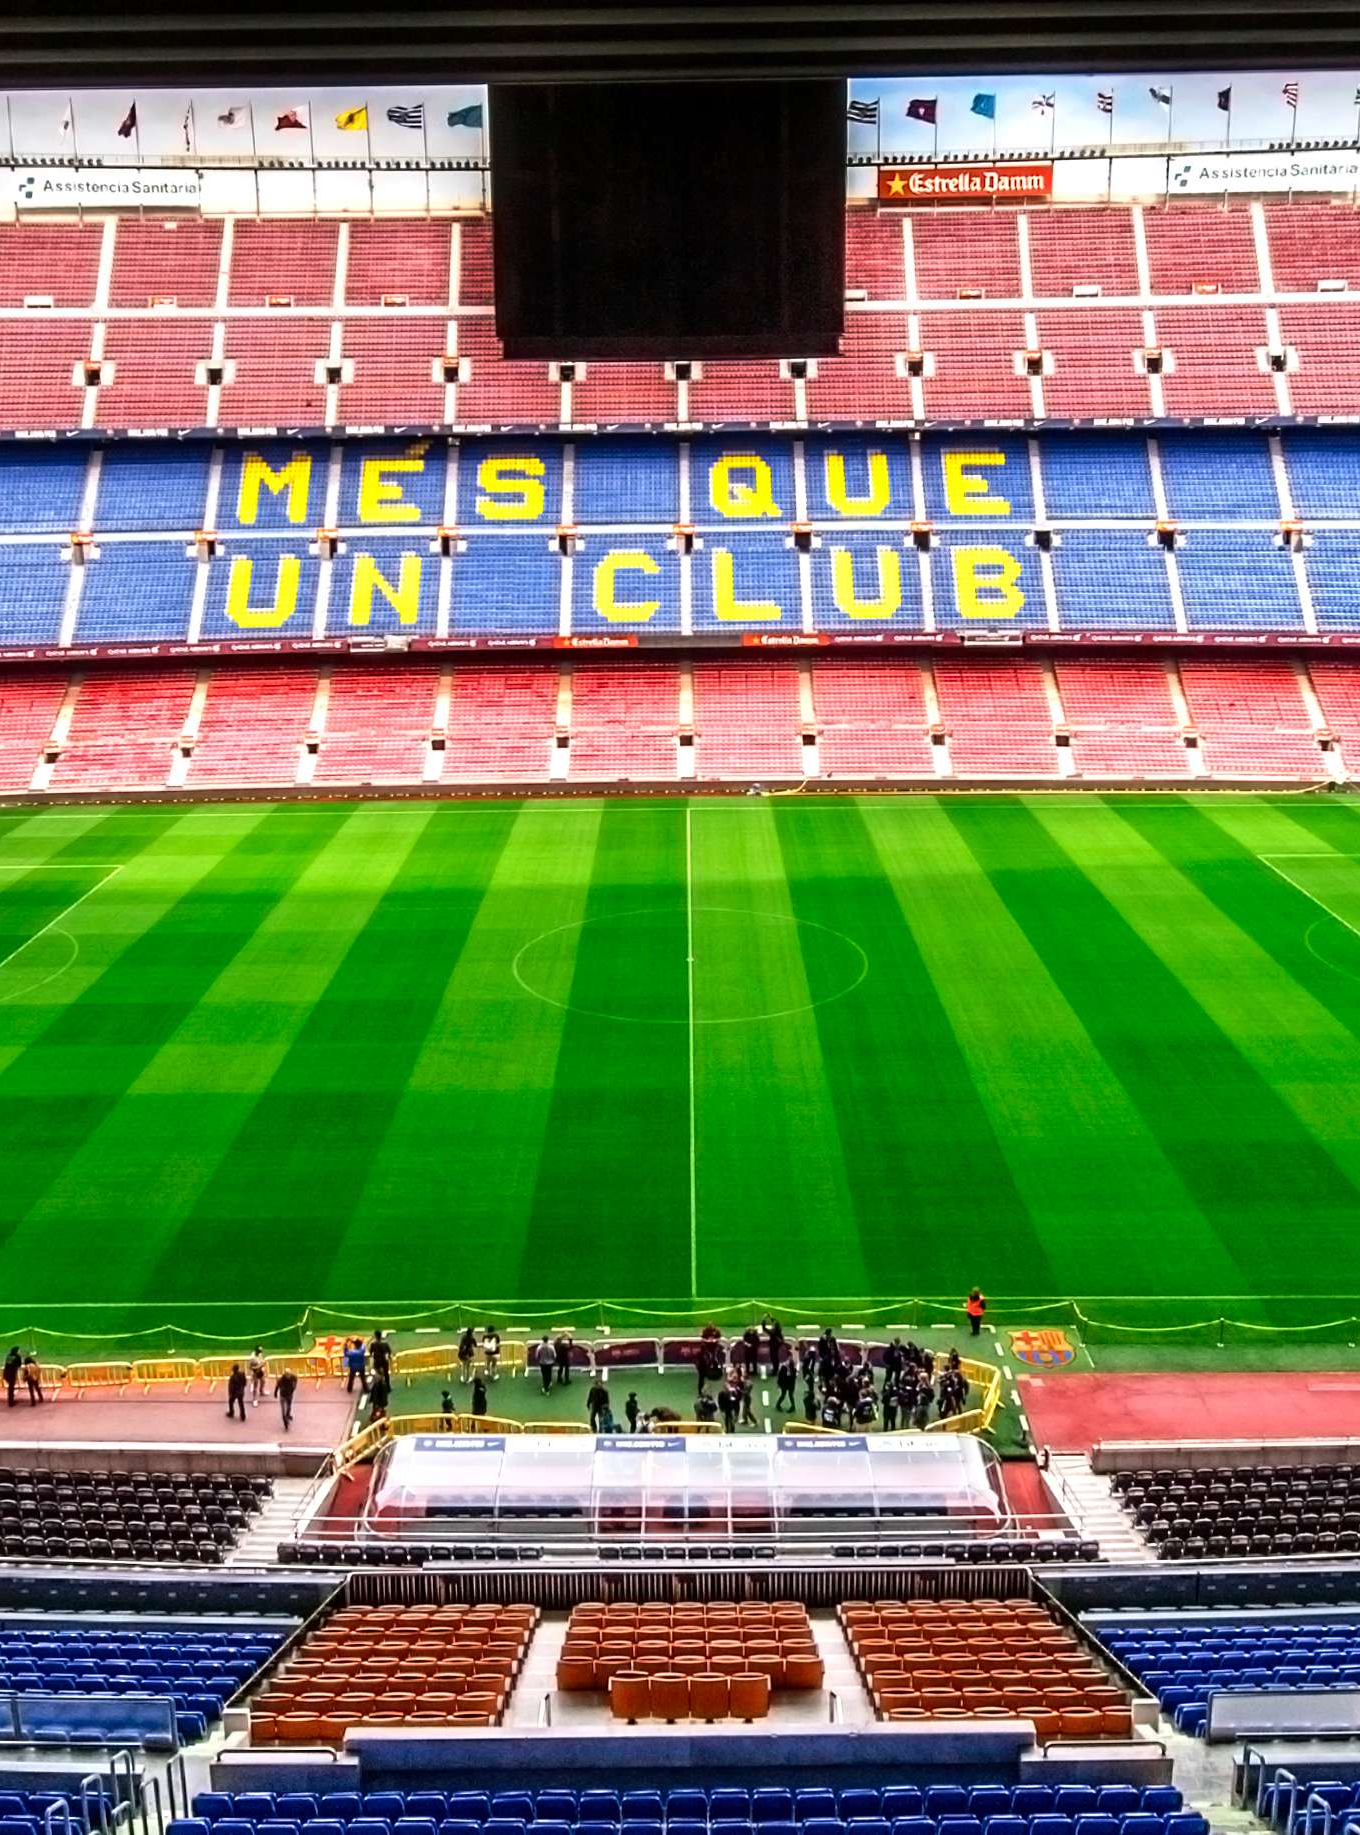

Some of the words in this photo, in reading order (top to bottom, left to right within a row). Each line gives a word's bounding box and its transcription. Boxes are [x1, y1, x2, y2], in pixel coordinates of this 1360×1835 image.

[909, 171, 982, 195] Estrella
[983, 171, 1045, 193] Damm
[239, 440, 546, 525] MÉS
[709, 451, 1012, 518] QUE
[227, 552, 423, 629] UN
[593, 548, 1026, 623] CLUB
